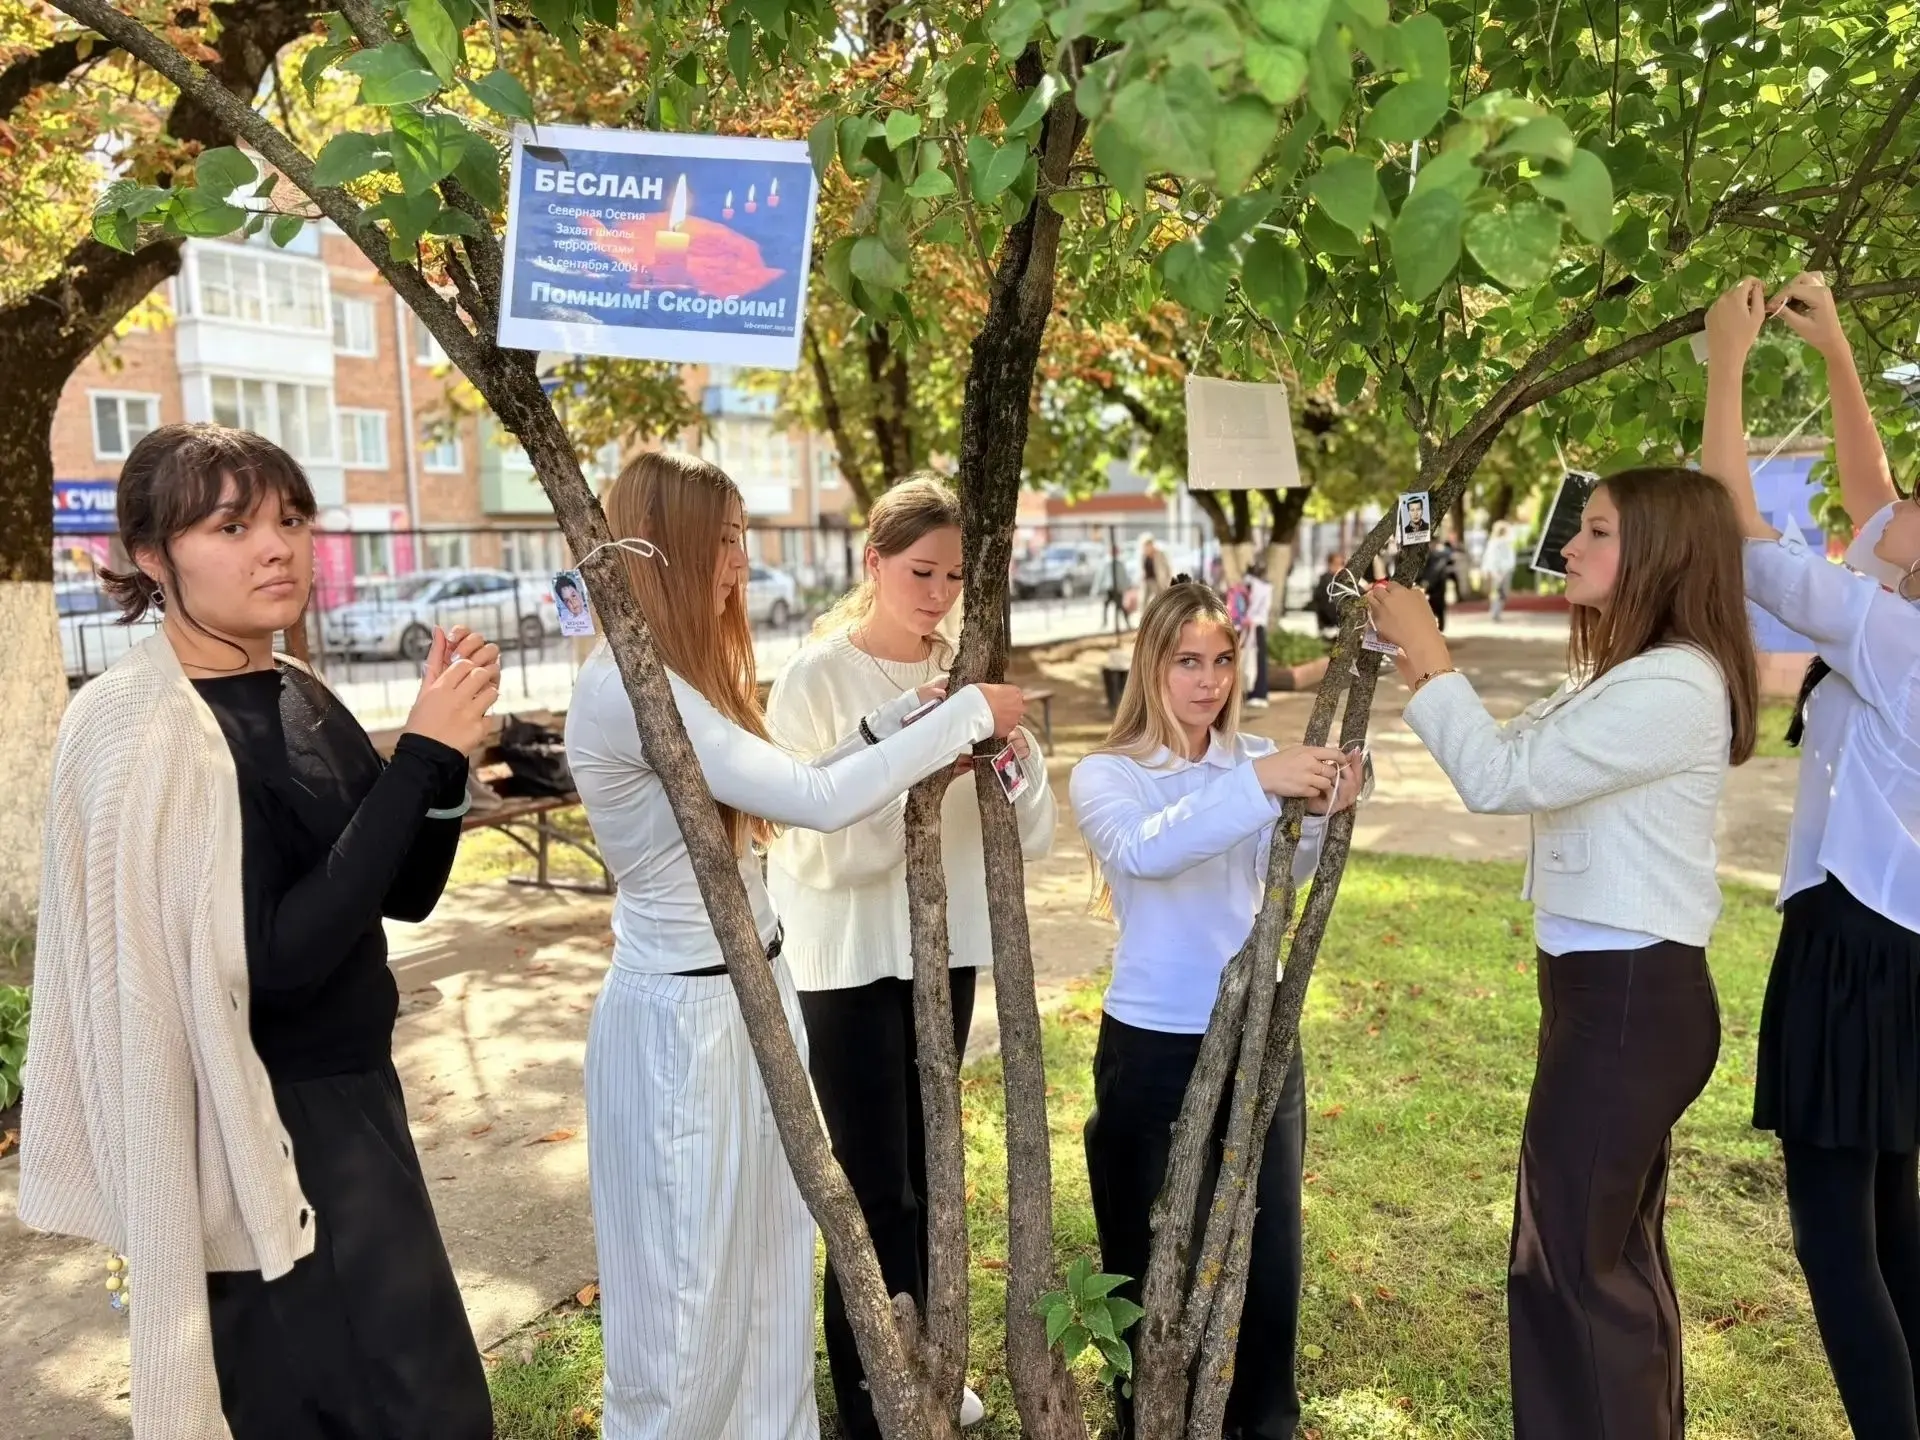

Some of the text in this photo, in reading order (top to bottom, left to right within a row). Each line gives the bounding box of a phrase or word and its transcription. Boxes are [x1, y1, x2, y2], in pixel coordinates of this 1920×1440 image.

[534, 168, 663, 200] БЕСЛАН
[547, 203, 646, 221] Северная Осетия
[555, 223, 635, 239] Захват школы
[553, 239, 635, 254] террористами
[556, 258, 609, 272] сентября
[611, 261, 638, 273] 2004
[640, 264, 649, 274] г.
[531, 281, 786, 319] Помним! Скорбим!
